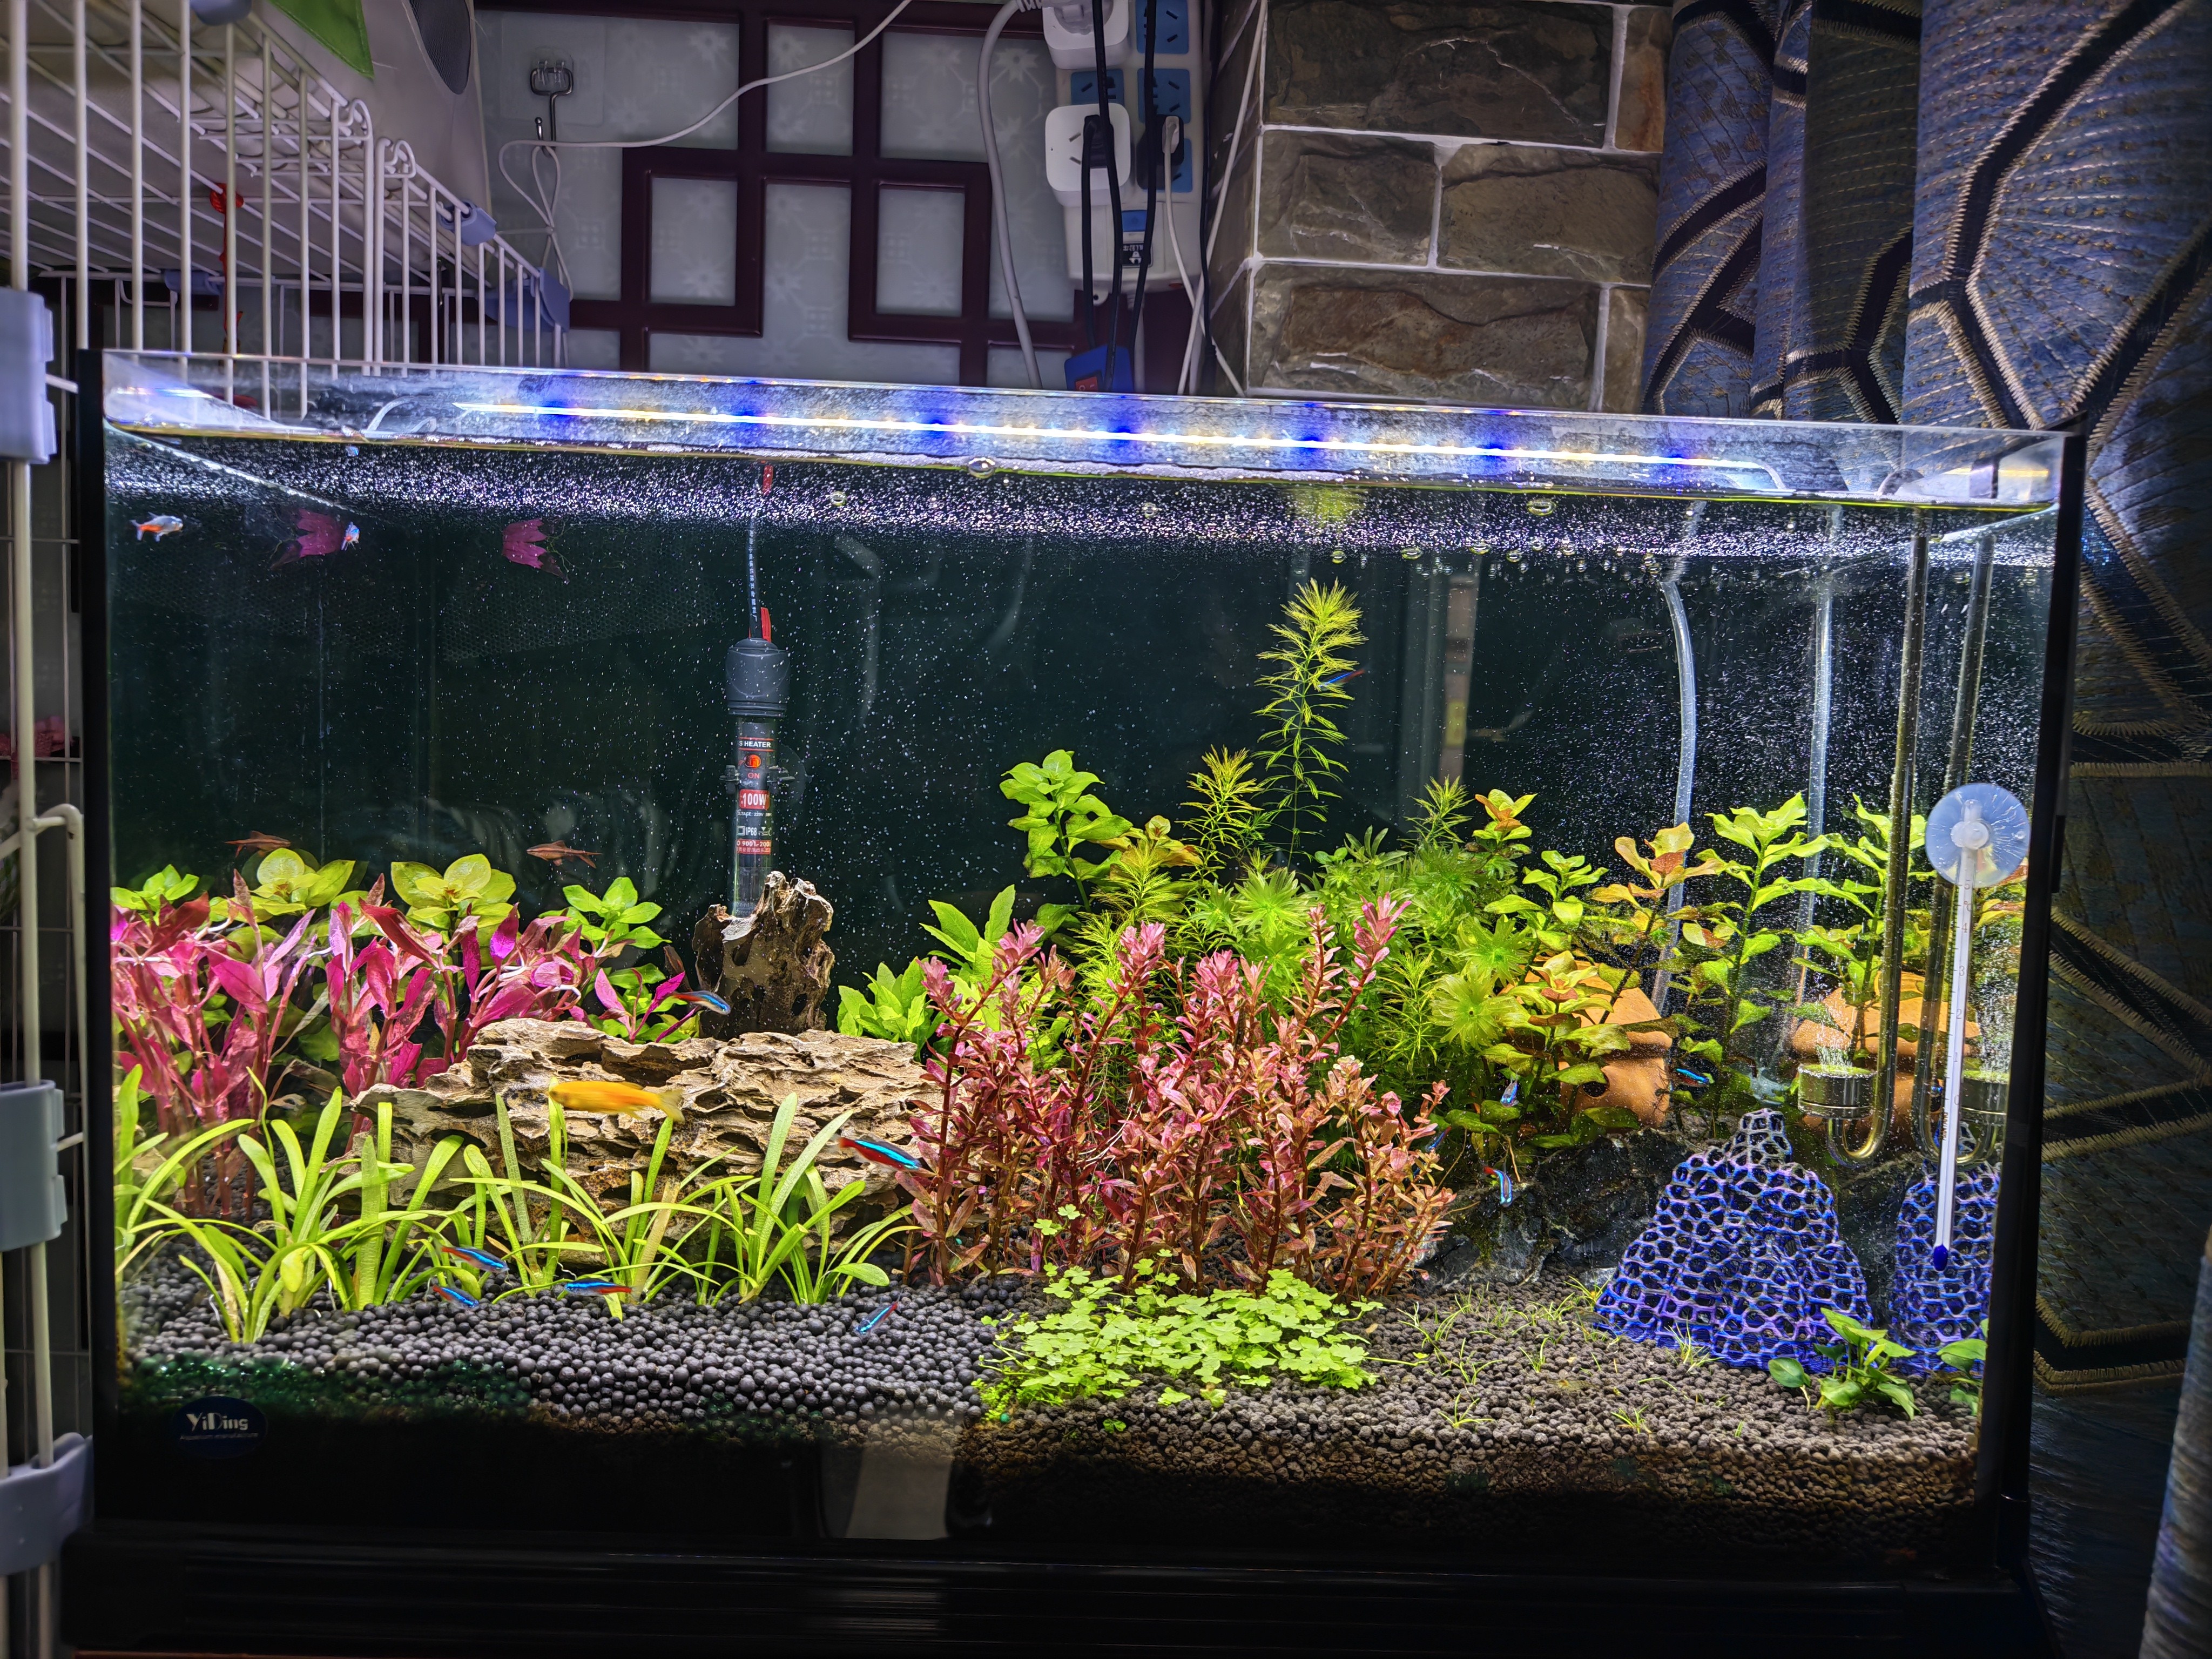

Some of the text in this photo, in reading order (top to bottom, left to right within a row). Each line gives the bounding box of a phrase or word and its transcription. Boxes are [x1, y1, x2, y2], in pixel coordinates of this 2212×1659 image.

[742, 793, 767, 807] 100W
[745, 827, 757, 836] IP68
[186, 1412, 248, 1432] YiDing
